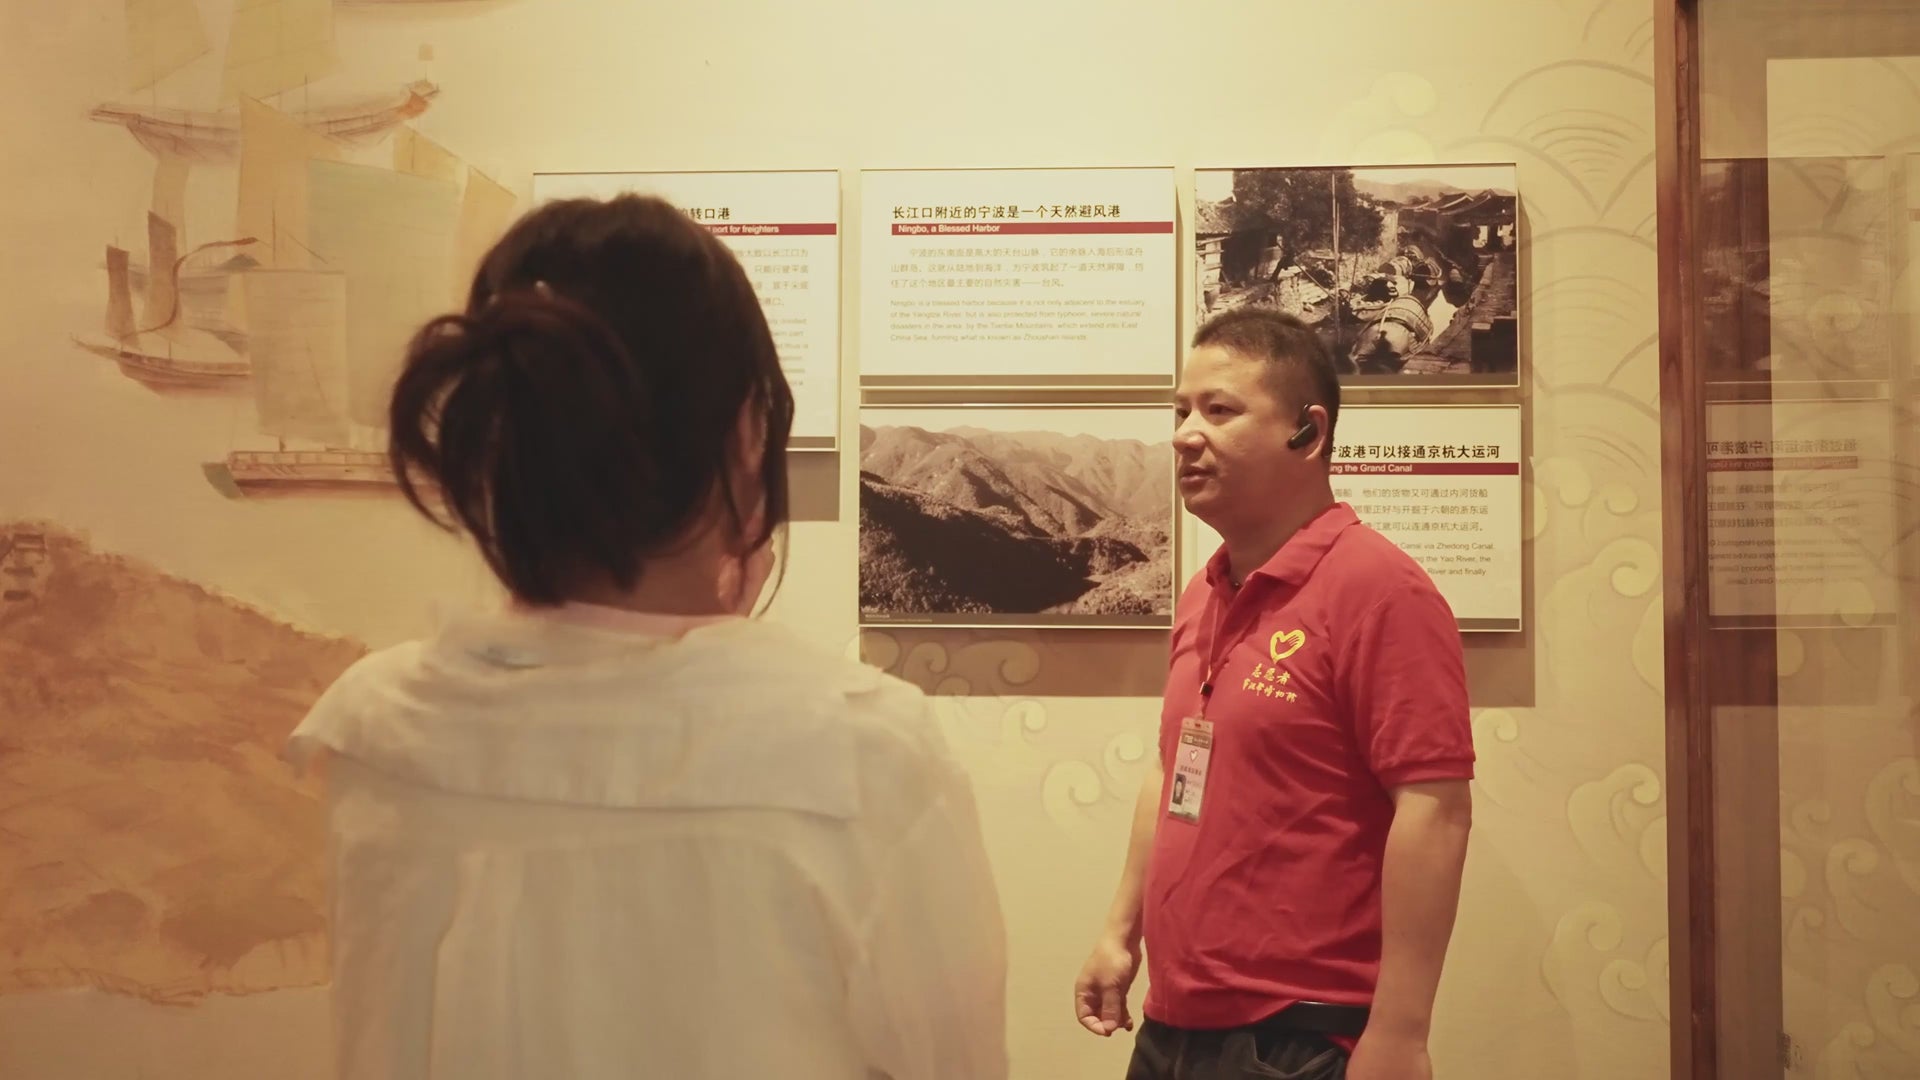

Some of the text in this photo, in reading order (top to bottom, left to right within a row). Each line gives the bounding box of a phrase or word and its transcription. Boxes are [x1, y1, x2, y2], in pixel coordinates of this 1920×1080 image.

[893, 205, 1122, 219] 长江口附近的宁波是一个天然避风港
[729, 225, 741, 233] for
[742, 224, 780, 235] freighters
[898, 225, 930, 234] Ningbo,
[938, 224, 971, 232] Blessed
[972, 224, 1000, 232] Harbor
[1345, 464, 1358, 472] the
[1360, 464, 1386, 473] Grand
[1388, 463, 1413, 472] Canal
[1436, 542, 1469, 551] Zhedong
[1465, 567, 1486, 576] finally
[1251, 663, 1291, 685] 志愿者
